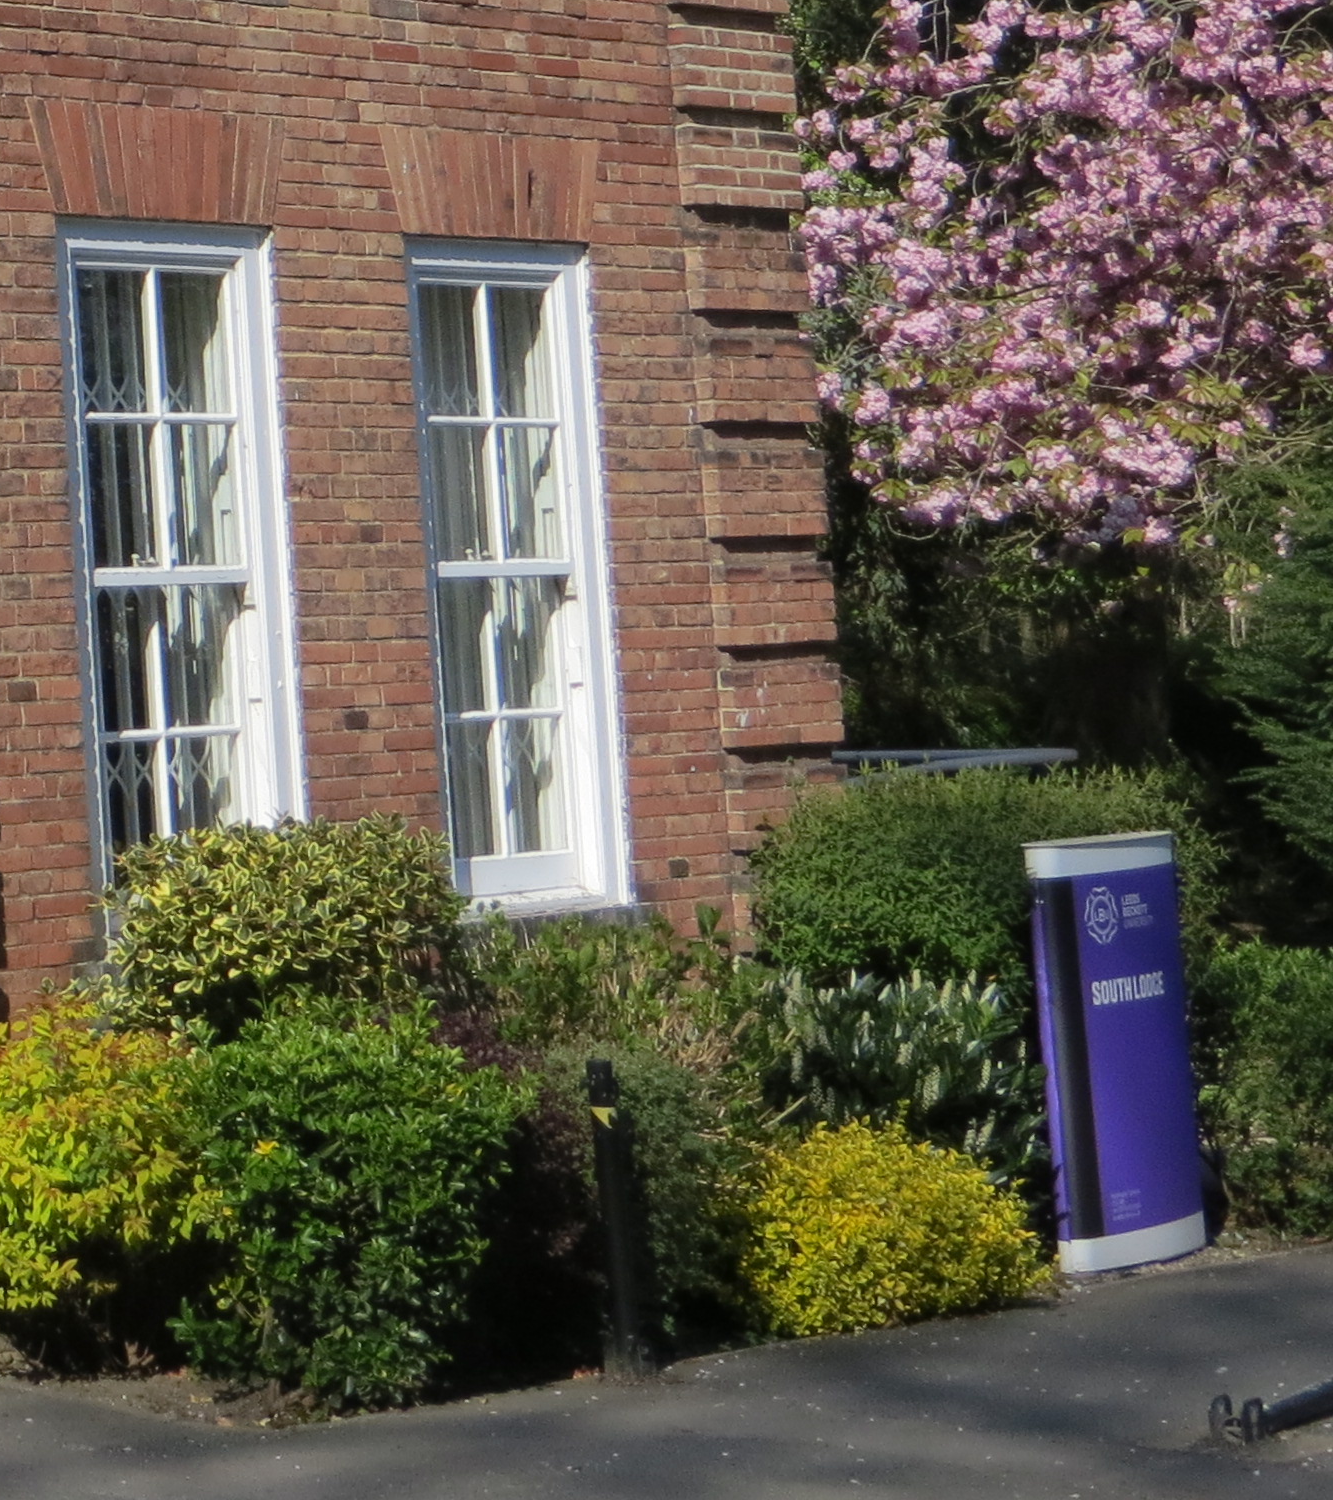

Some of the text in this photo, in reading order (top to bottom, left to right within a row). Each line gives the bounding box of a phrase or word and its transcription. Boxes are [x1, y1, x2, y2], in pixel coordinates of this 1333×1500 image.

[1121, 893, 1140, 906] LEEDS
[1122, 903, 1148, 917] BECKETT
[1091, 970, 1165, 1006] SOUTH LODGE
